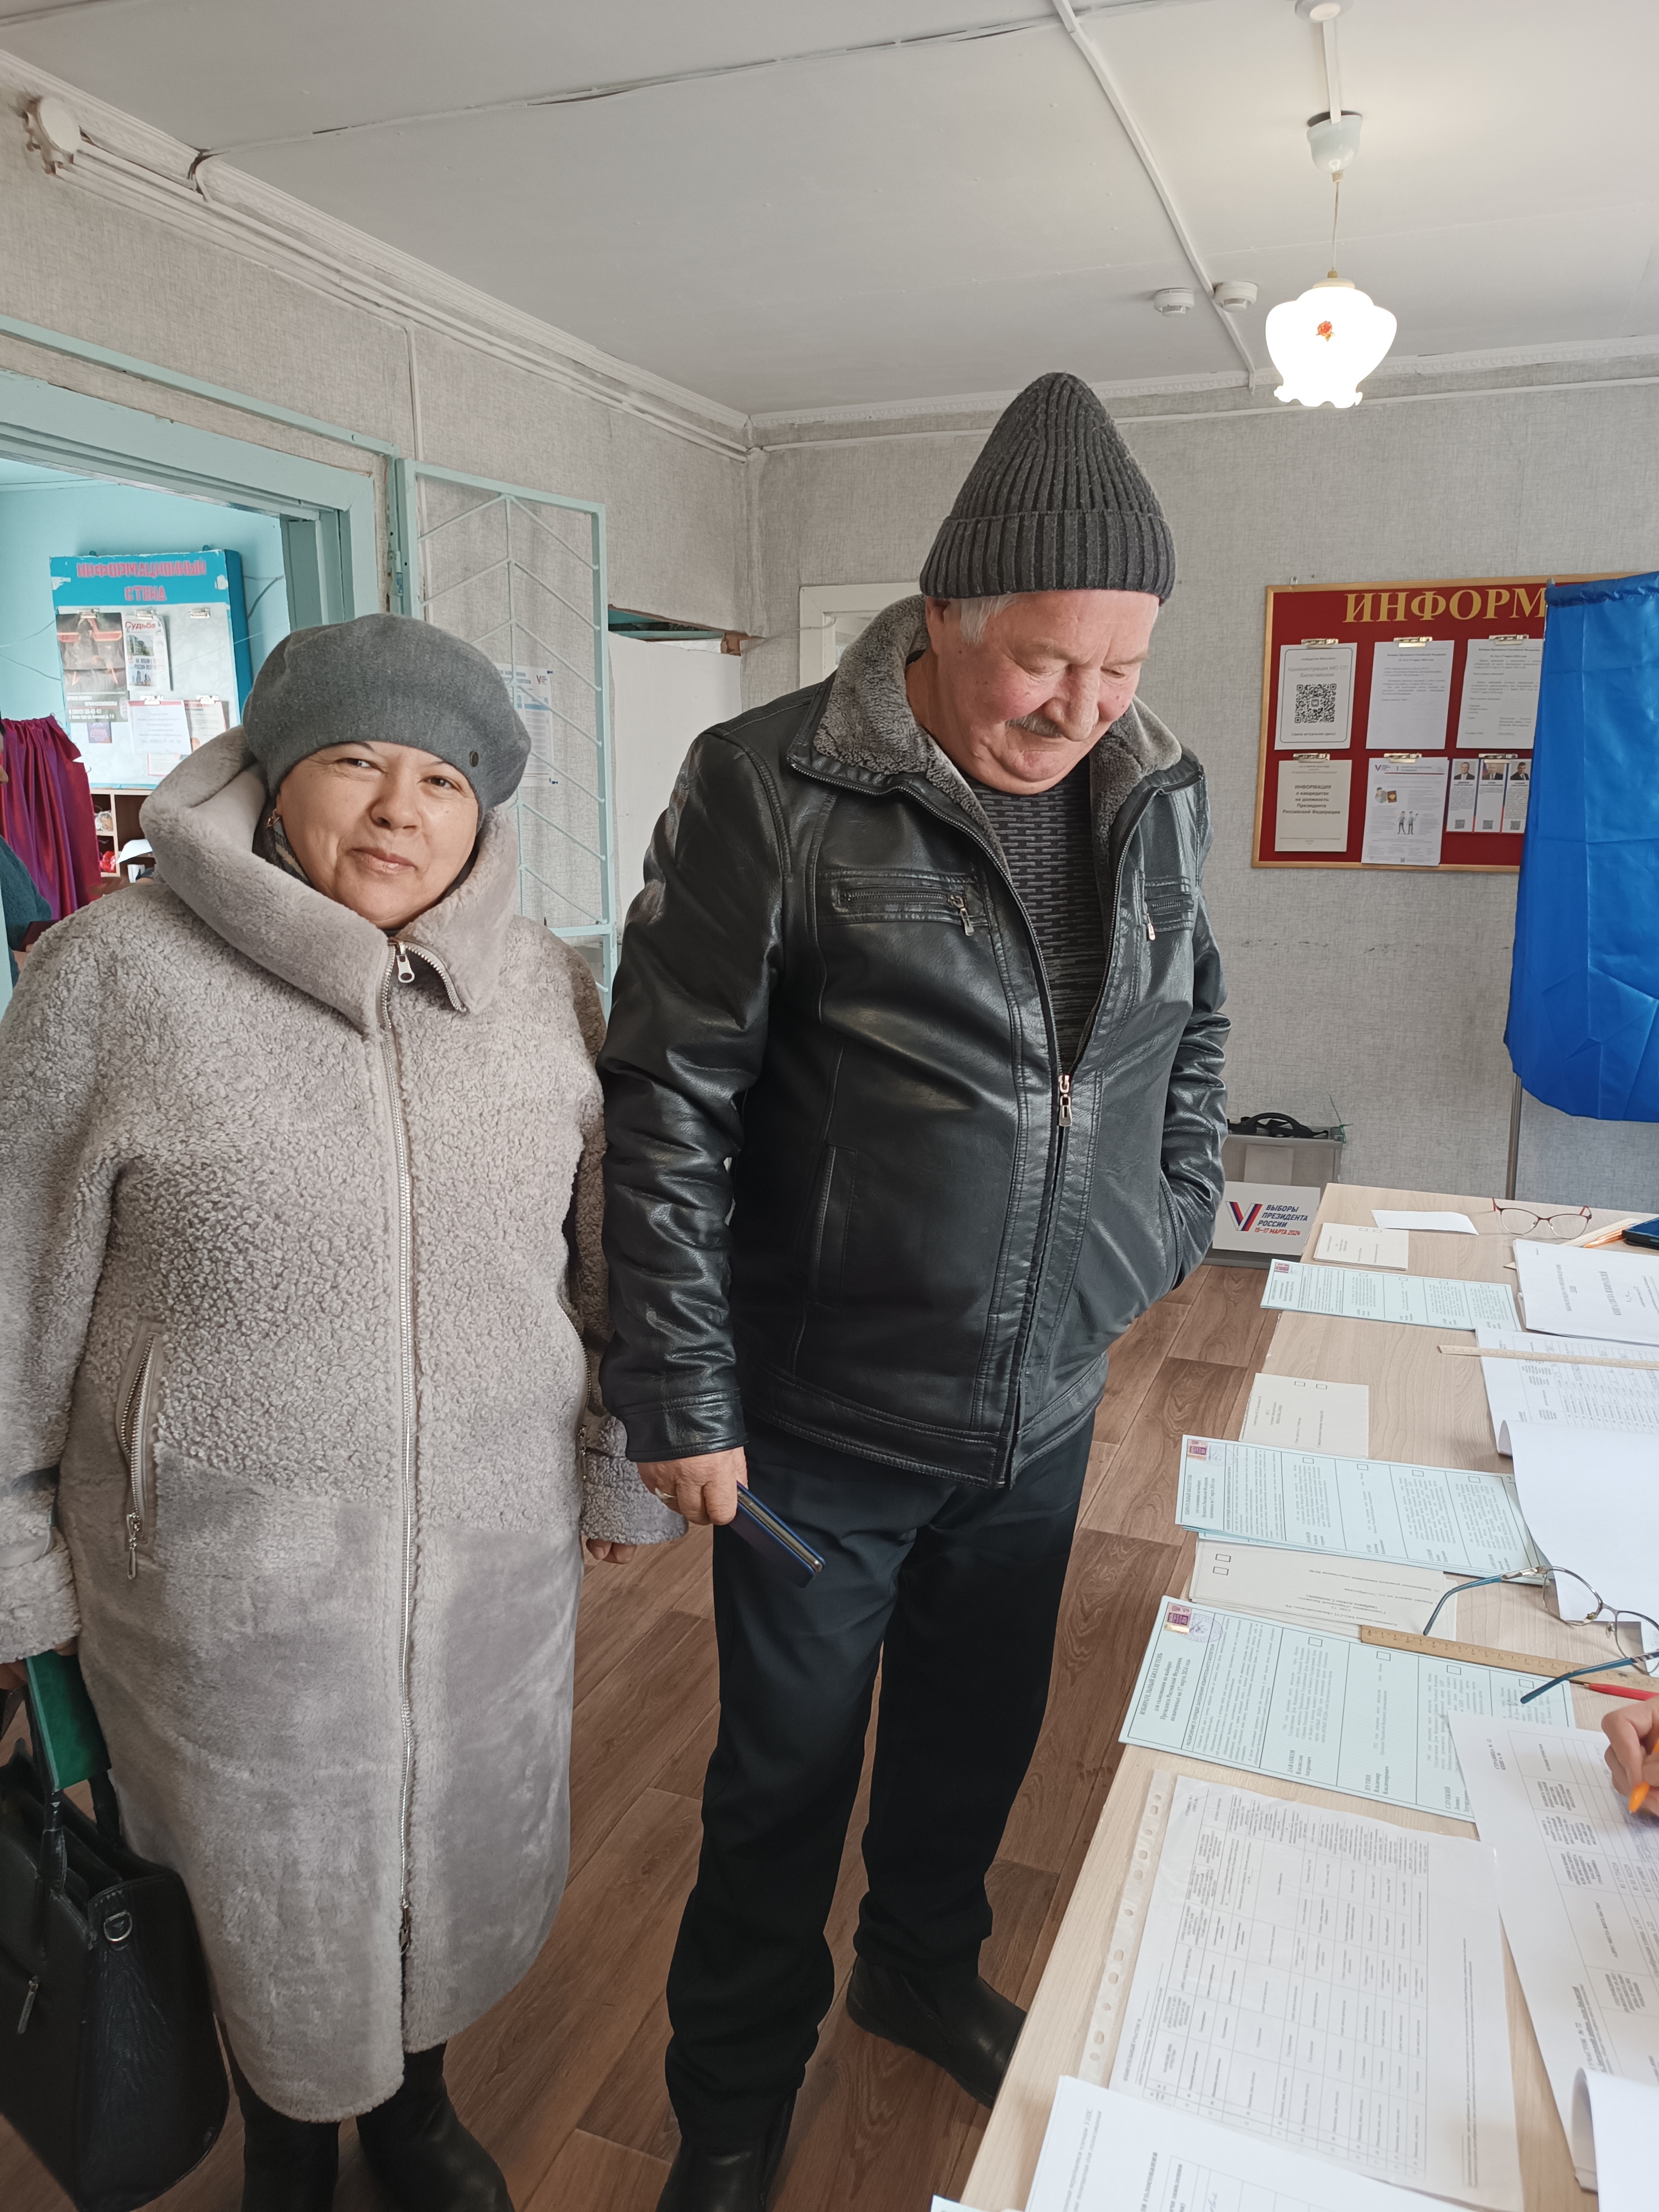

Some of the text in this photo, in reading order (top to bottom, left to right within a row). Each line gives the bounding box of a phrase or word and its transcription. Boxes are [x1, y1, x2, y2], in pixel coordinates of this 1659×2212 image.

[76, 557, 207, 578] ИНФОРМАЦИОННЫЙ
[124, 585, 167, 601] СТЕНД
[125, 621, 156, 630] Судьба
[1266, 1204, 1299, 1213] ВЫБОРЫ
[1258, 1220, 1288, 1228] РОССИИ
[1261, 1212, 1308, 1222] ПРЕЗИДЕНТА
[1140, 1653, 1162, 1715] ИЗБИРАТЕЛЬНЫЙ БЮЛЛЕТЕНЬ
[1160, 1657, 1183, 1720] Президента Российской Федерации,
[1171, 1697, 1180, 1721] назначенных
